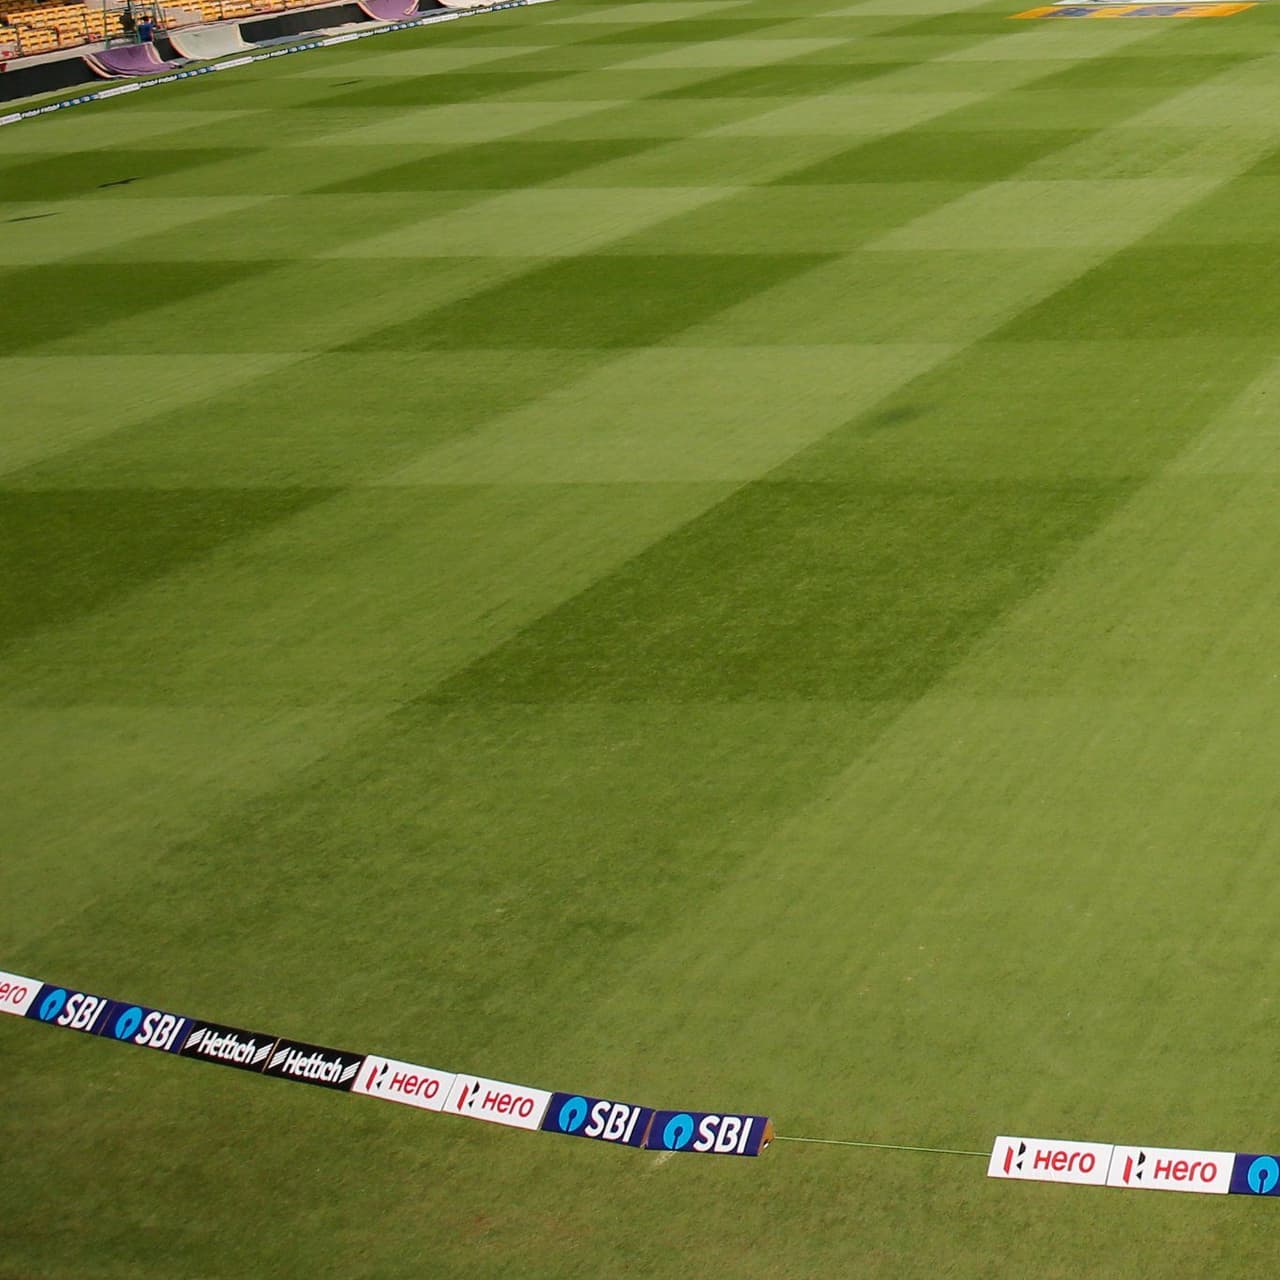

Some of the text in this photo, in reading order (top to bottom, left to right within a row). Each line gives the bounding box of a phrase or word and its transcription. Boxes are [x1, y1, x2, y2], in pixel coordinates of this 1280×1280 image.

[57, 994, 104, 1032] SBI
[134, 1010, 184, 1049] SBI
[201, 1030, 256, 1064] Hettich
[284, 1050, 341, 1083] Hettich
[391, 1071, 440, 1101] Hero
[484, 1089, 535, 1119] Hero
[584, 1100, 639, 1143] SBI
[693, 1116, 755, 1154] SBI
[1033, 1150, 1095, 1173] Hero
[1154, 1159, 1217, 1183] Hero
